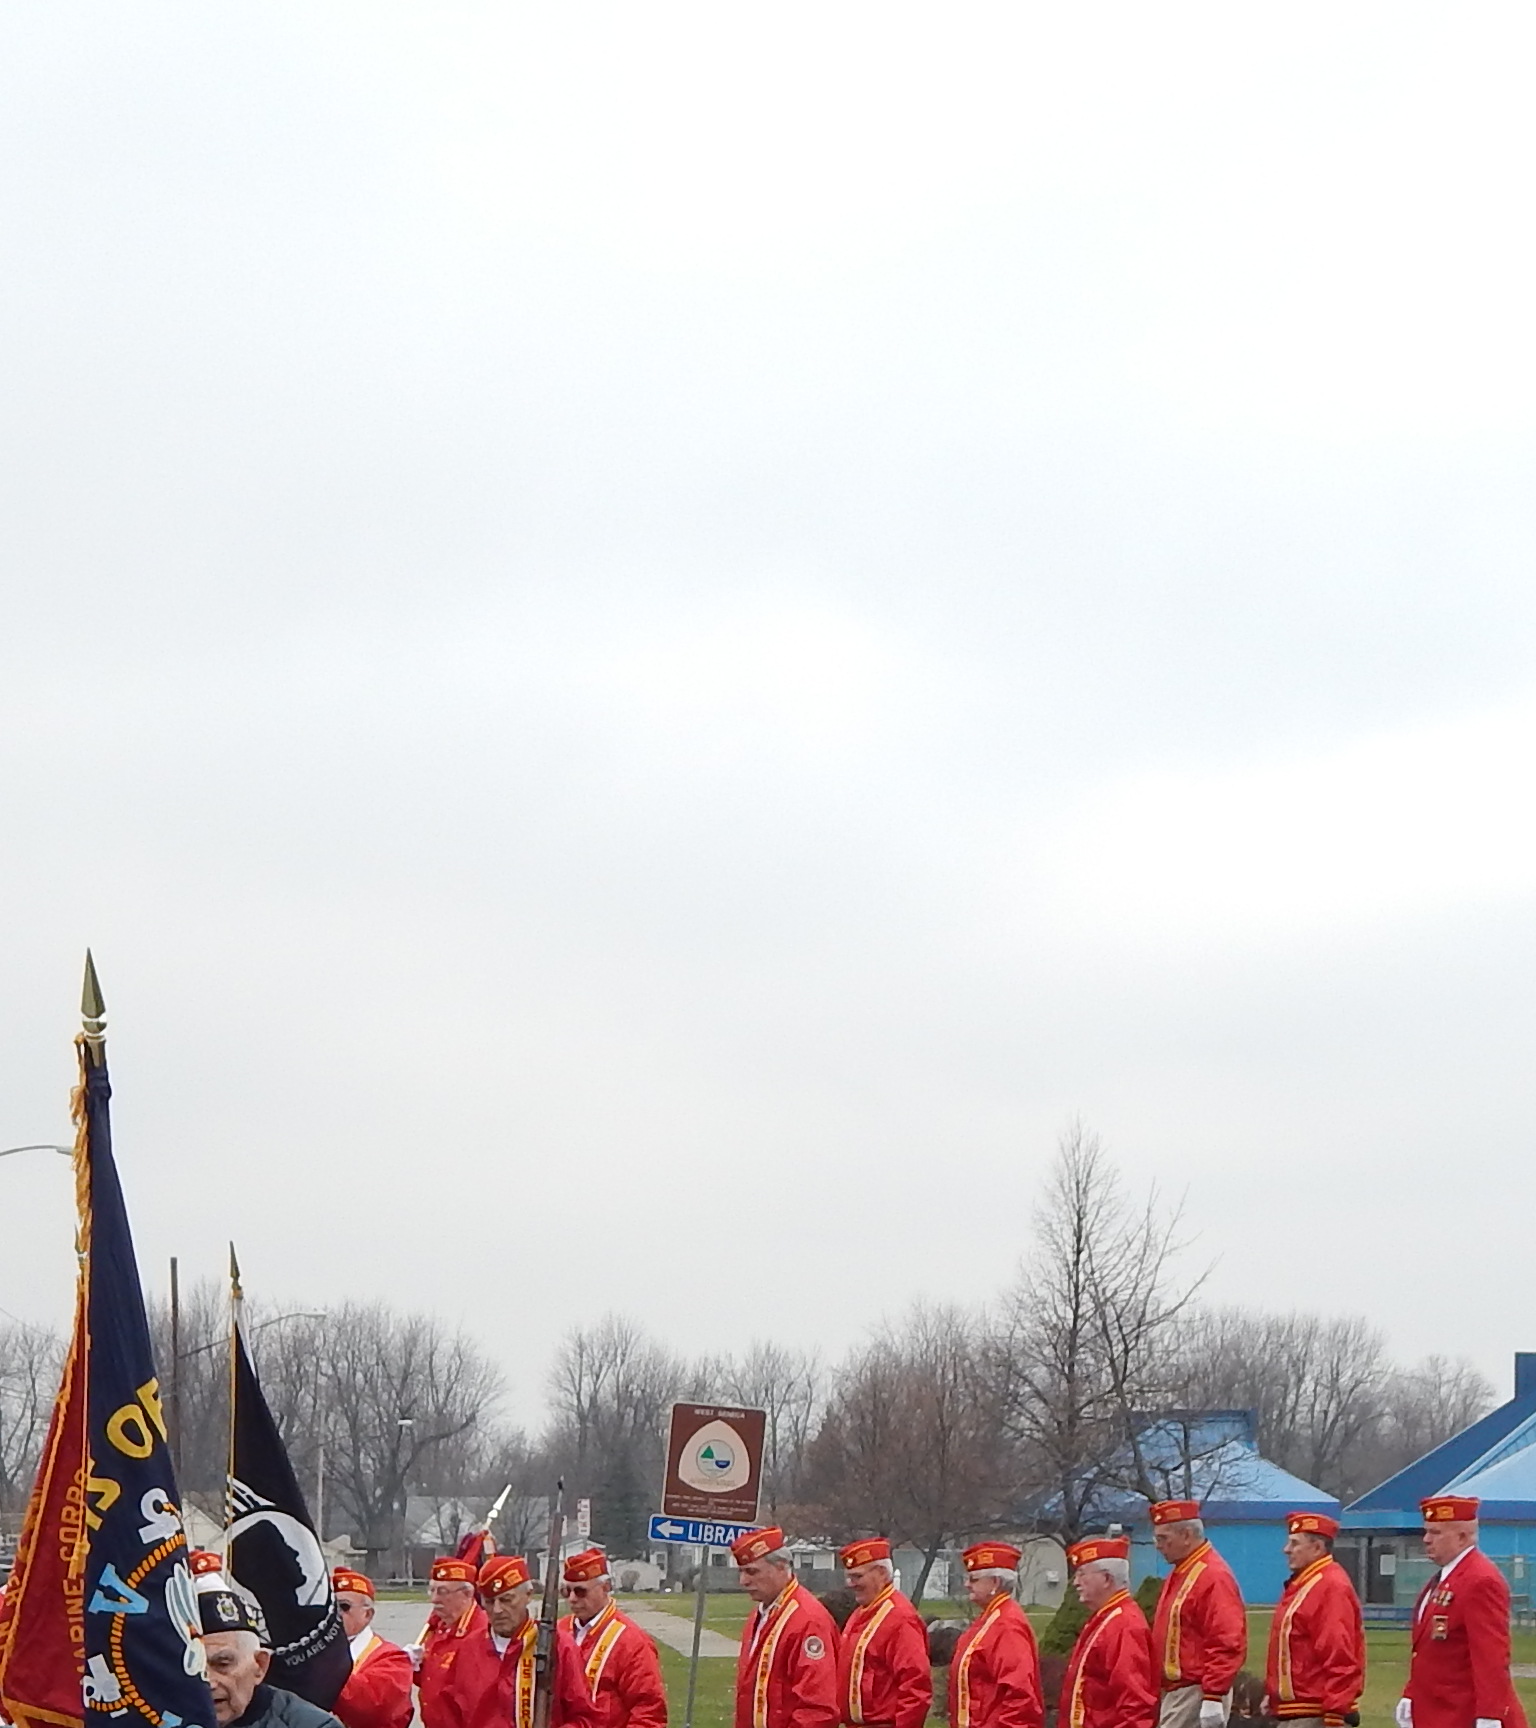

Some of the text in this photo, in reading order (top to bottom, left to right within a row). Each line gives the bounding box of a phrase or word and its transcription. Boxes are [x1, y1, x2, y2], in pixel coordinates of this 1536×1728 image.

[284, 1623, 341, 1666] YOU ARE NOT
